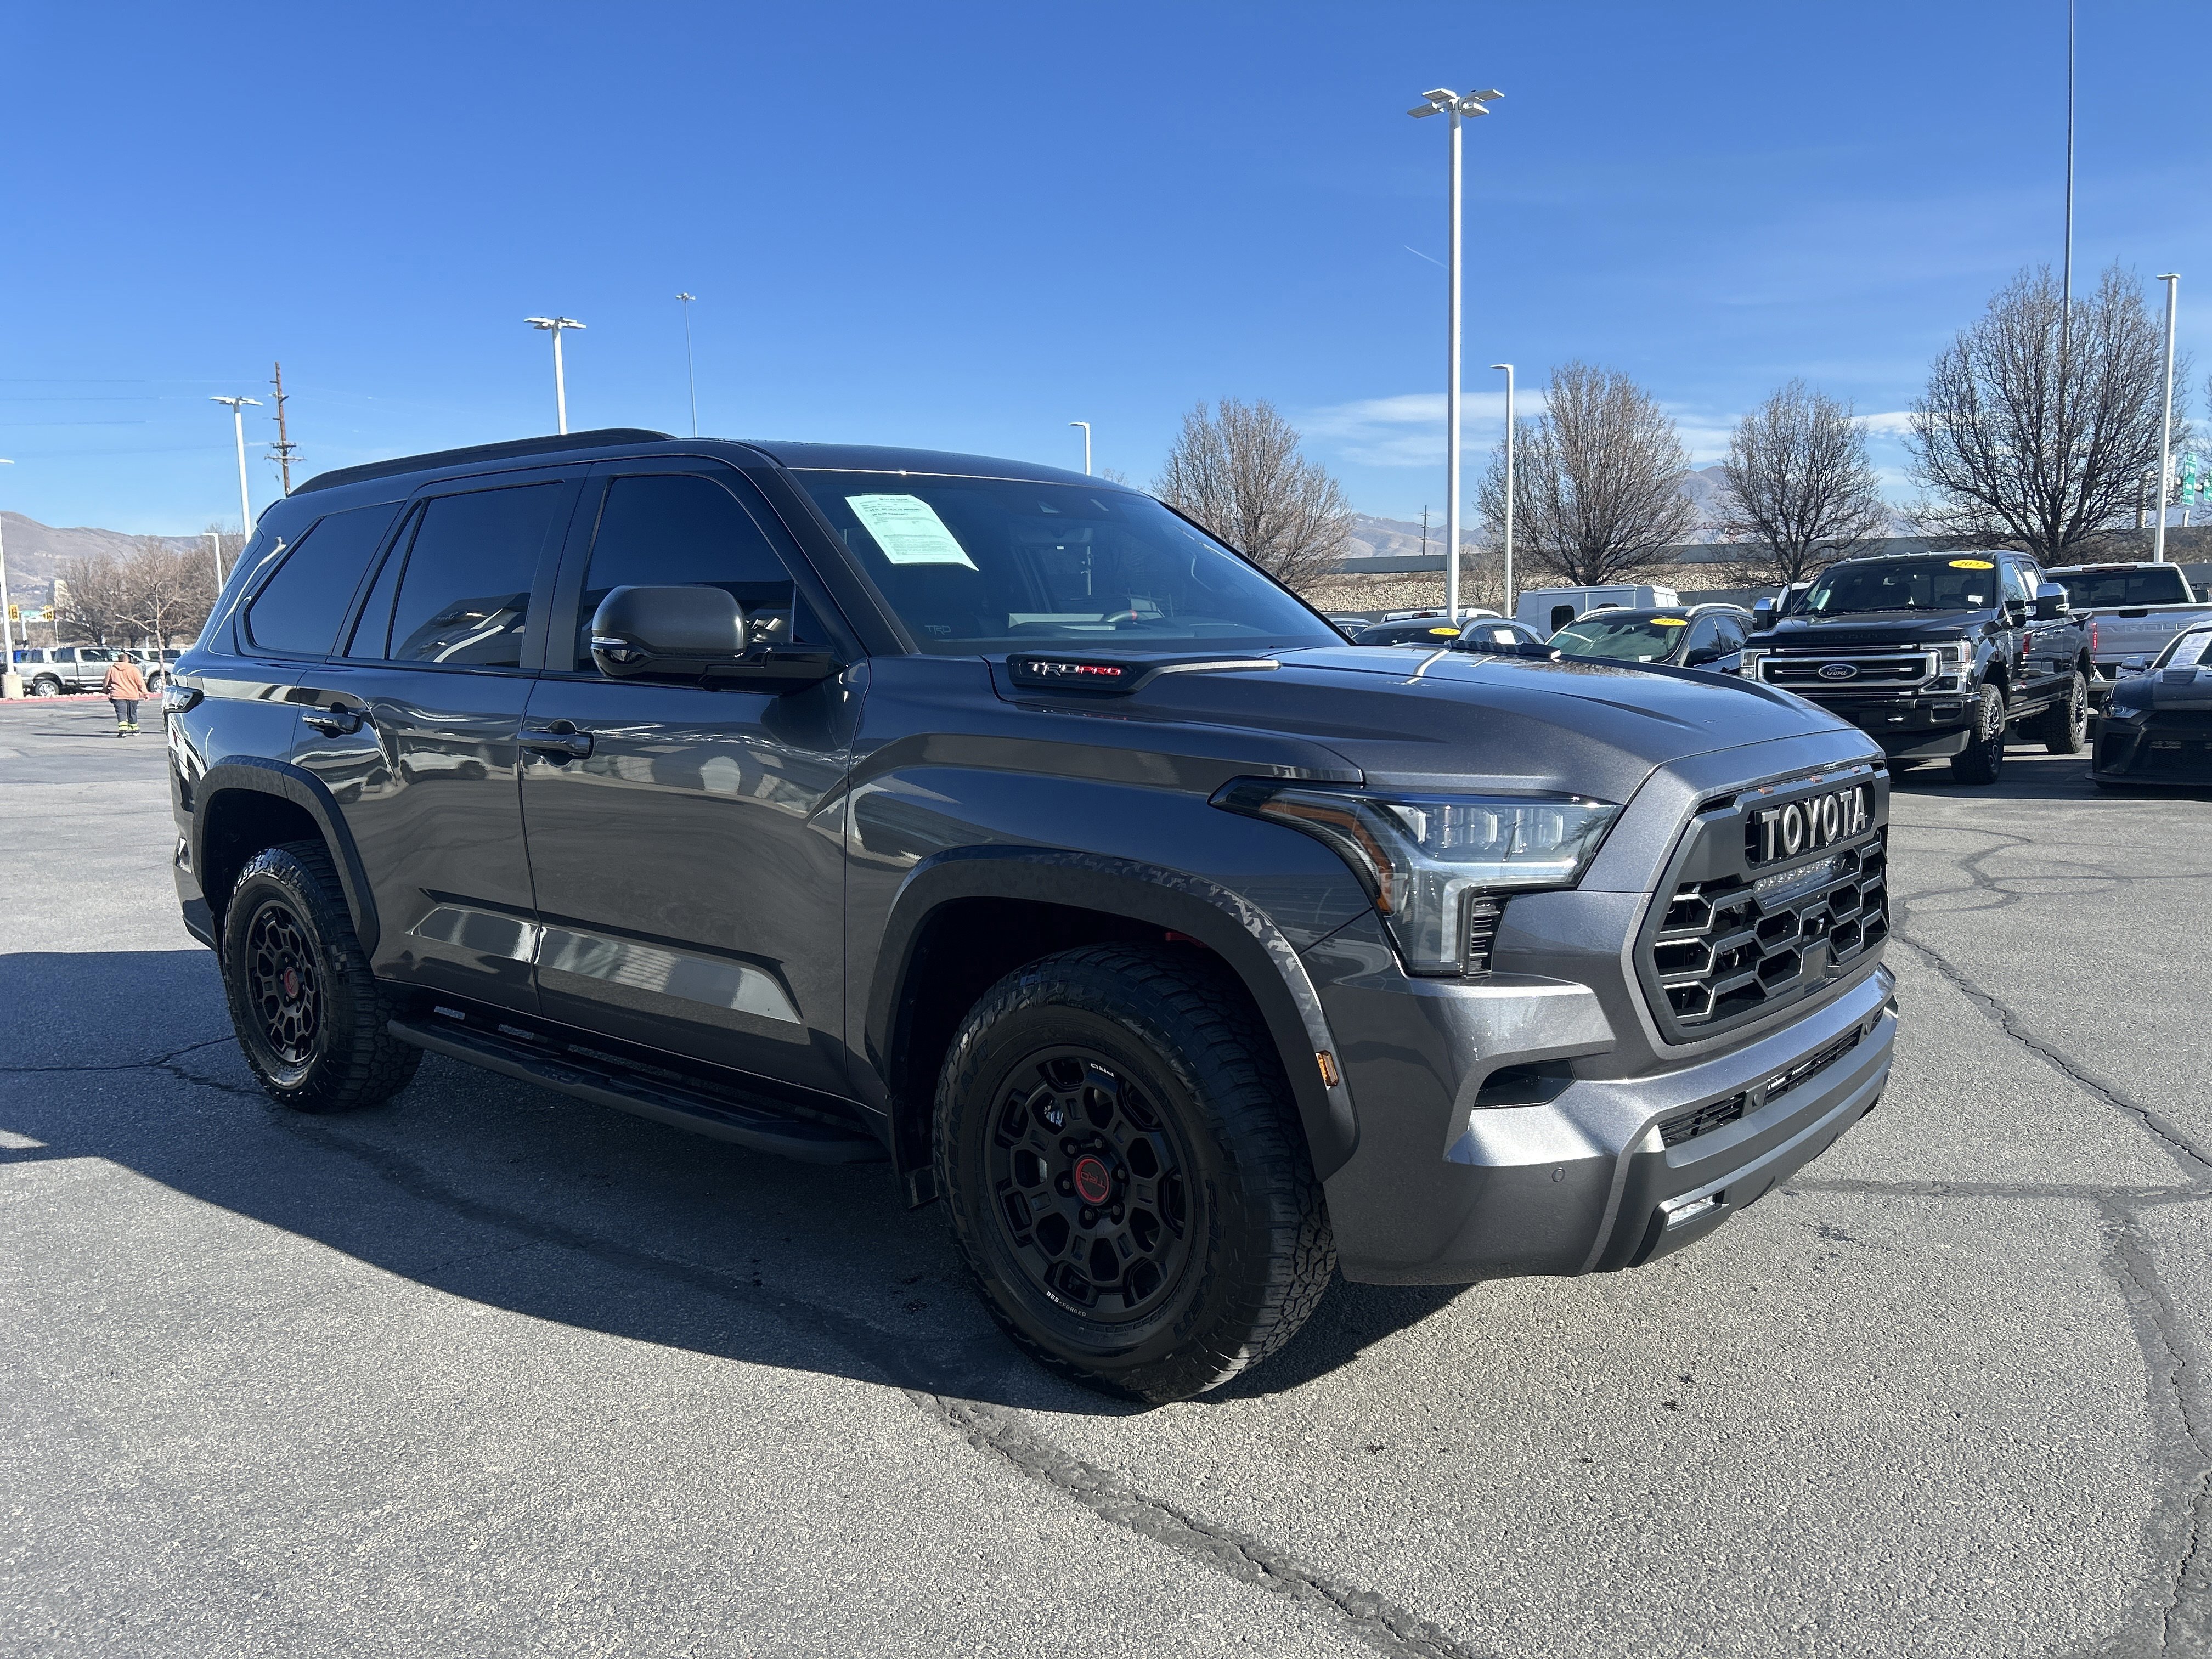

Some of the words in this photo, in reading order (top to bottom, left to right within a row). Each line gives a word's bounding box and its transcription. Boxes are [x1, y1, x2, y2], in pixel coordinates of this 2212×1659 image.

[924, 625, 951, 635] TRD
[1028, 661, 1080, 677] TRD
[1079, 665, 1122, 676] PRO
[1826, 667, 1848, 676] Ford
[1761, 786, 1866, 861] TOYOTA
[1081, 1171, 1106, 1189] TRD
